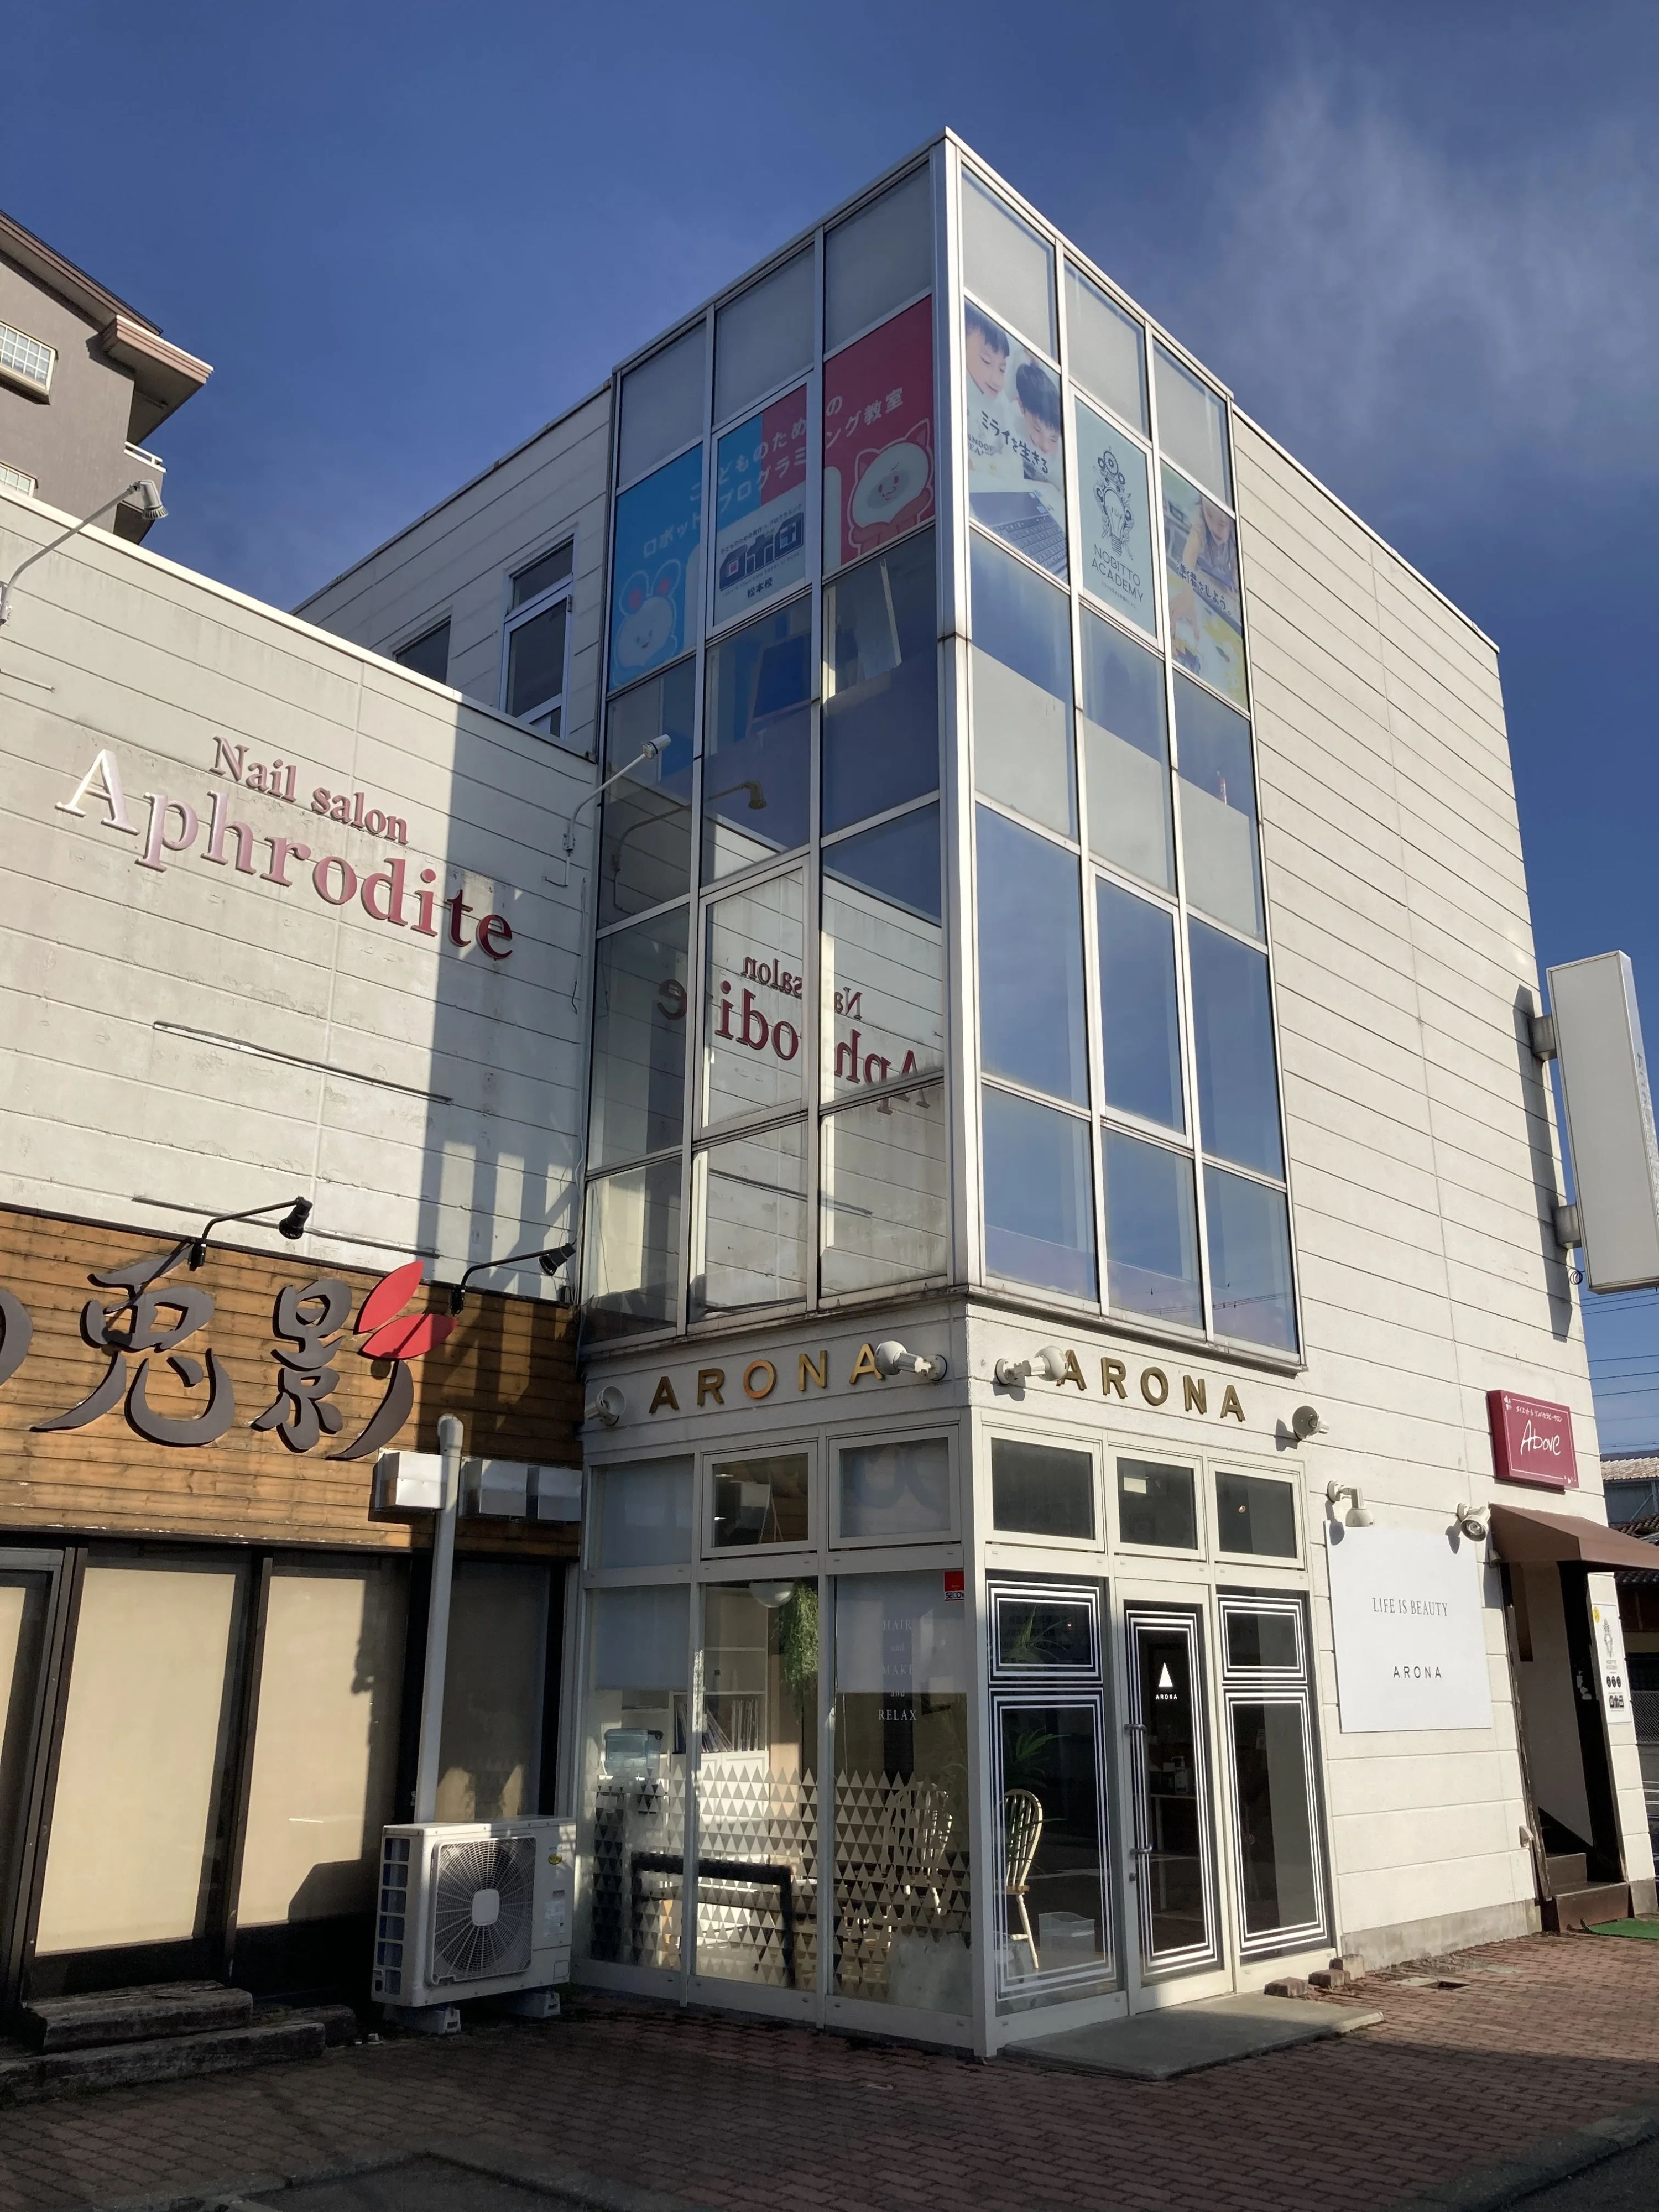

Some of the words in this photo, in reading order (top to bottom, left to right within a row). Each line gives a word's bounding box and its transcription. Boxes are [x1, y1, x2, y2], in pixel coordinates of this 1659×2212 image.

[982, 410, 1048, 474] ミライを生きる
[1092, 558, 1144, 602] ACADEMY
[1094, 544, 1140, 586] NOBITTO
[747, 577, 773, 598] 松本校
[210, 735, 297, 803] Nail
[311, 786, 409, 845] salon
[55, 748, 514, 960] Aphrodite
[649, 1343, 884, 1414] ARONA
[1056, 1349, 1246, 1422] ARONA
[1520, 1419, 1561, 1456] Above
[883, 1619, 911, 1631] HAIR
[1373, 1598, 1395, 1614] LIFE
[1398, 1599, 1407, 1614] IS
[1410, 1600, 1447, 1616] BEAUTY
[890, 1642, 905, 1652] and
[1394, 1666, 1442, 1679] ARONA
[890, 1688, 905, 1697] and
[878, 1709, 917, 1721] RELAX
